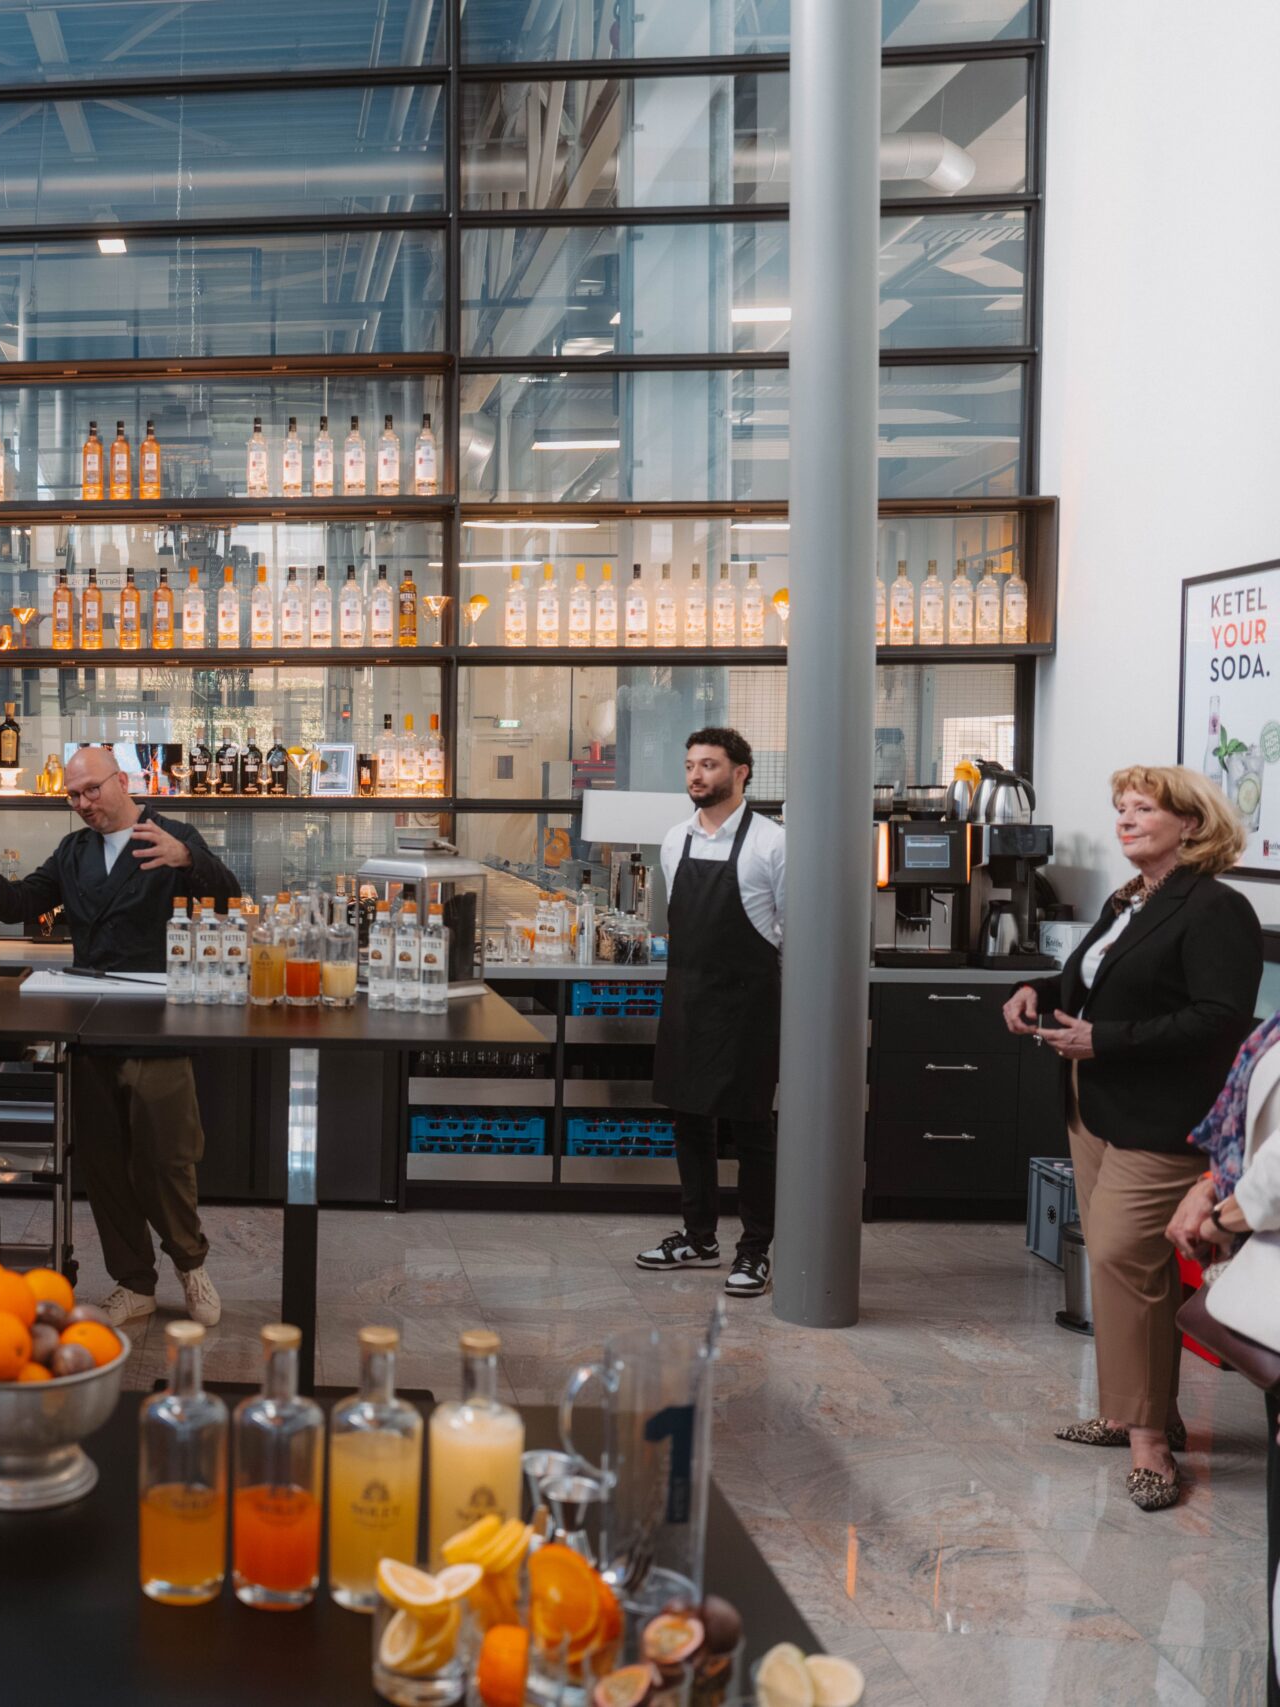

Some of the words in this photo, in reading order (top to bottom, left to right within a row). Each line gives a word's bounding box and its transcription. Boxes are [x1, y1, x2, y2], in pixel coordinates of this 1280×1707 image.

[1210, 587, 1268, 618] KETEL
[1212, 619, 1267, 650] YOUR
[1210, 653, 1270, 682] SODA.
